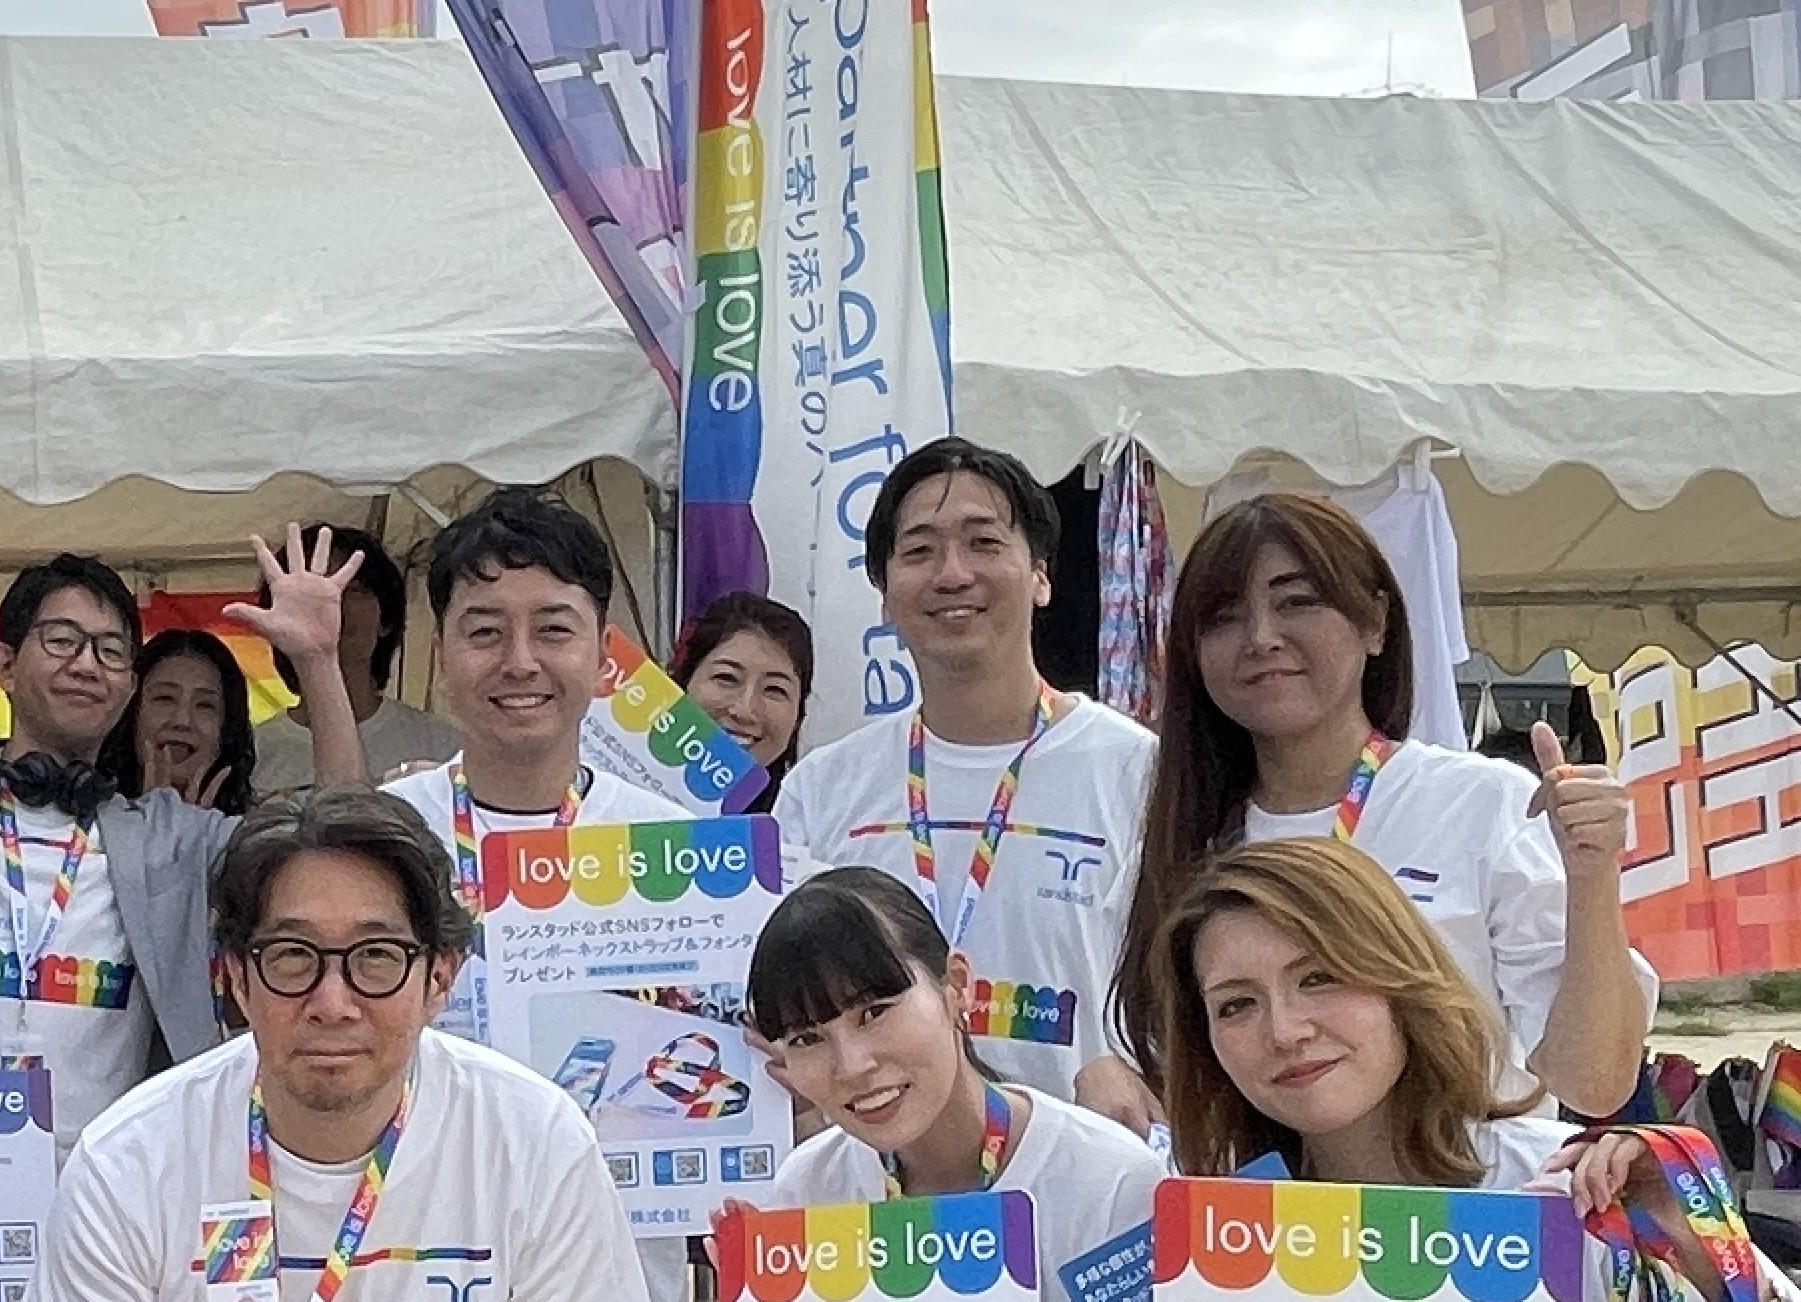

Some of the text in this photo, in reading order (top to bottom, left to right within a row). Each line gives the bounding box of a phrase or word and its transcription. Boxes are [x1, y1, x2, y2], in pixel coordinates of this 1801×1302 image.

[708, 27, 759, 412] love is love
[829, 424, 908, 570] fo
[861, 622, 914, 716] ta
[648, 704, 677, 734] is
[675, 724, 734, 789] love
[519, 839, 747, 882] love is love
[1022, 1000, 1060, 1023] love
[755, 1221, 996, 1276] love is love
[1204, 1205, 1531, 1271] love is love
